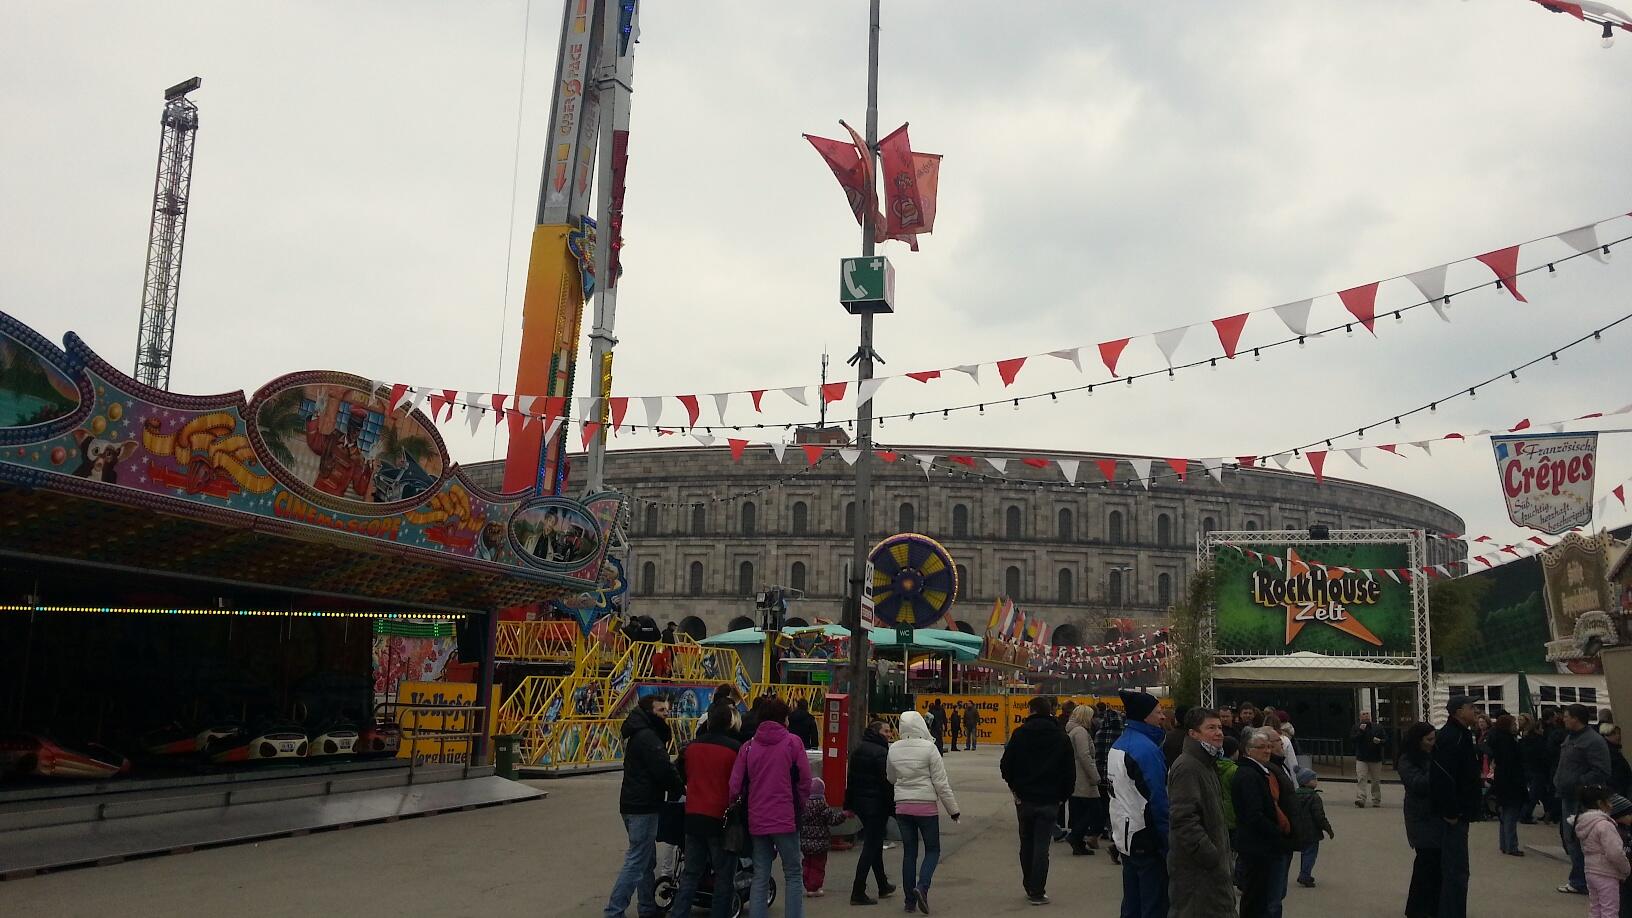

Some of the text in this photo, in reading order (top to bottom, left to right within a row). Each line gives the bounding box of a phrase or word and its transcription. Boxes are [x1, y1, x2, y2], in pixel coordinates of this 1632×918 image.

[1523, 439, 1596, 460] Französische
[1505, 453, 1594, 498] Crêpes
[1295, 601, 1347, 621] Zelt
[899, 629, 910, 637] WC
[922, 700, 953, 710] Jeen
